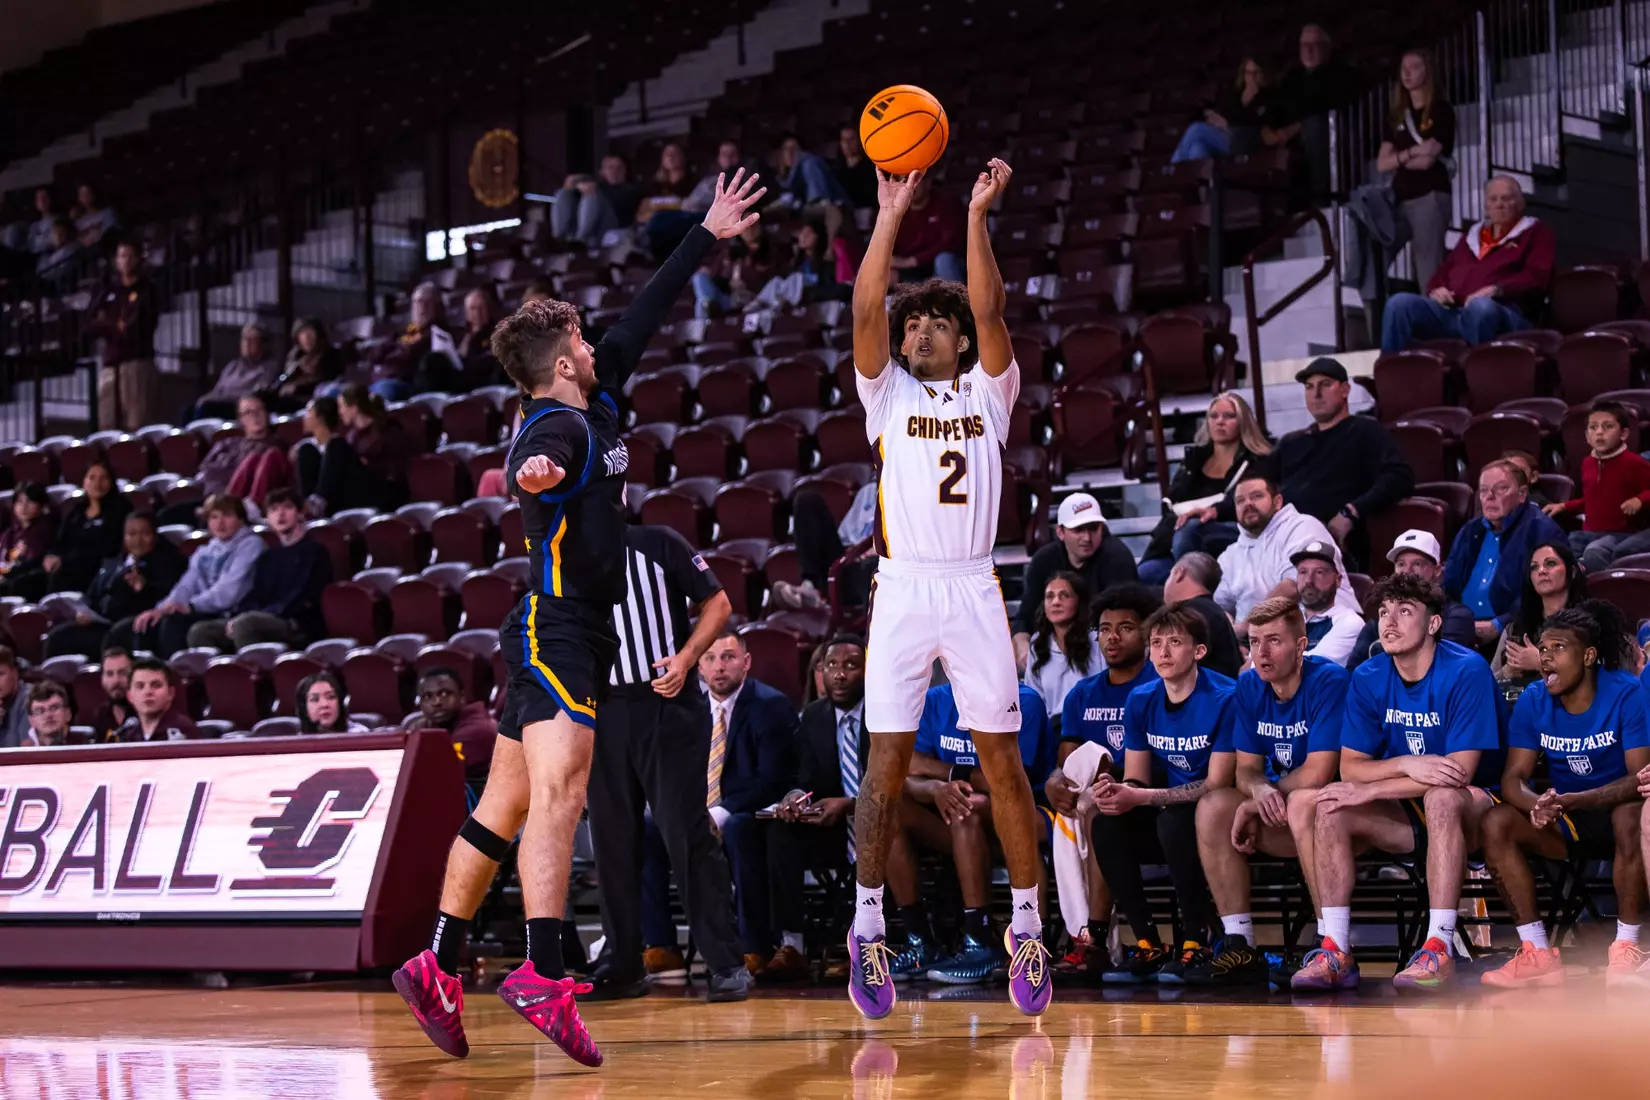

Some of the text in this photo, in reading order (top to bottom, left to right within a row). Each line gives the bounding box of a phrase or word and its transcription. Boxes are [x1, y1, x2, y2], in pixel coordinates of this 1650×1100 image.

[938, 450, 968, 505] 2
[1083, 707, 1118, 721] NORTH
[1177, 735, 1211, 751] PARK
[1540, 729, 1617, 752] NORTH PARK
[1571, 761, 1590, 775] NP
[0, 779, 222, 896] BALL
